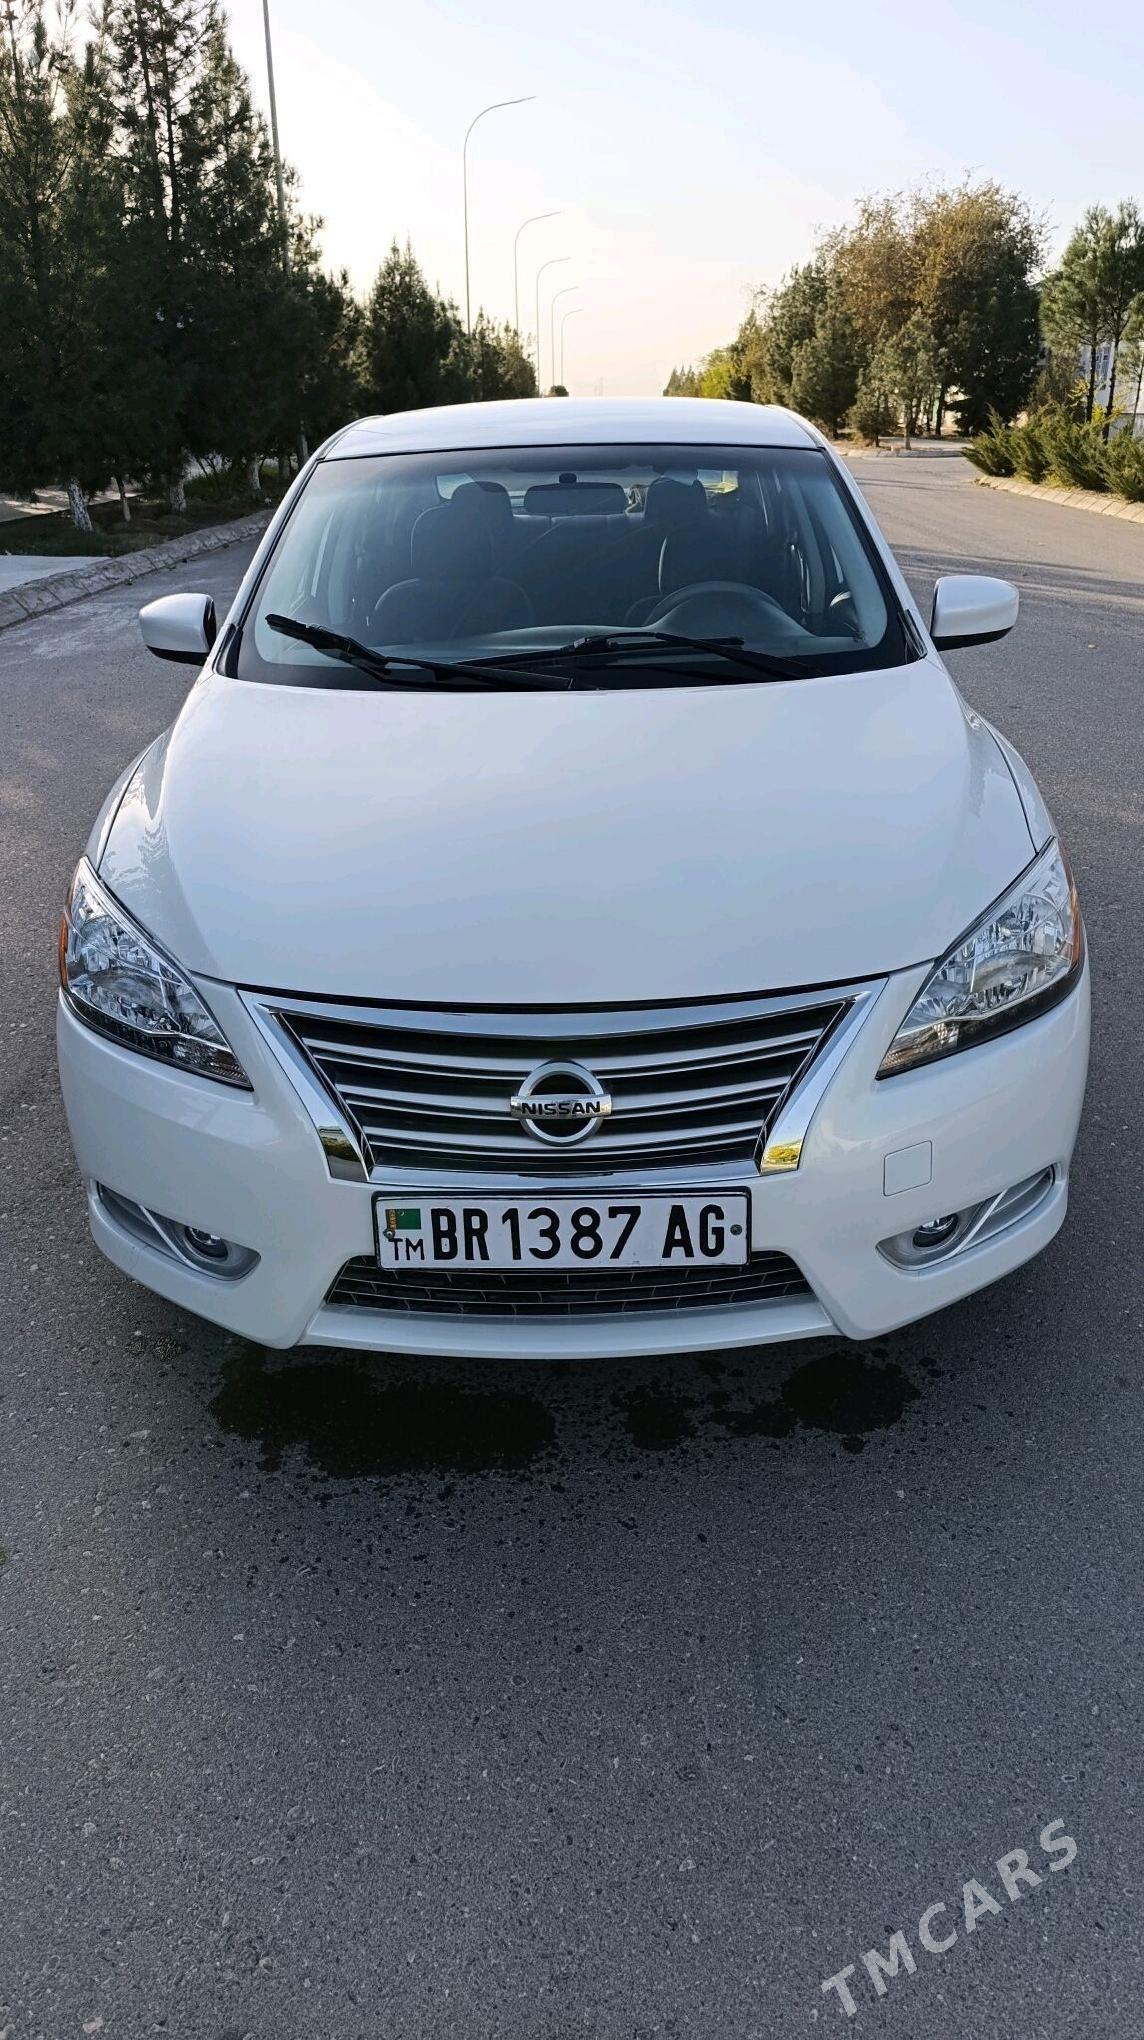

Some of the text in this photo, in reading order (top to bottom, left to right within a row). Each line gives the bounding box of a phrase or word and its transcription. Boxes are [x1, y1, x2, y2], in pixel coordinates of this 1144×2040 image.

[521, 1100, 601, 1116] NISSAN
[661, 1204, 725, 1258] AG
[389, 1238, 425, 1261] TM
